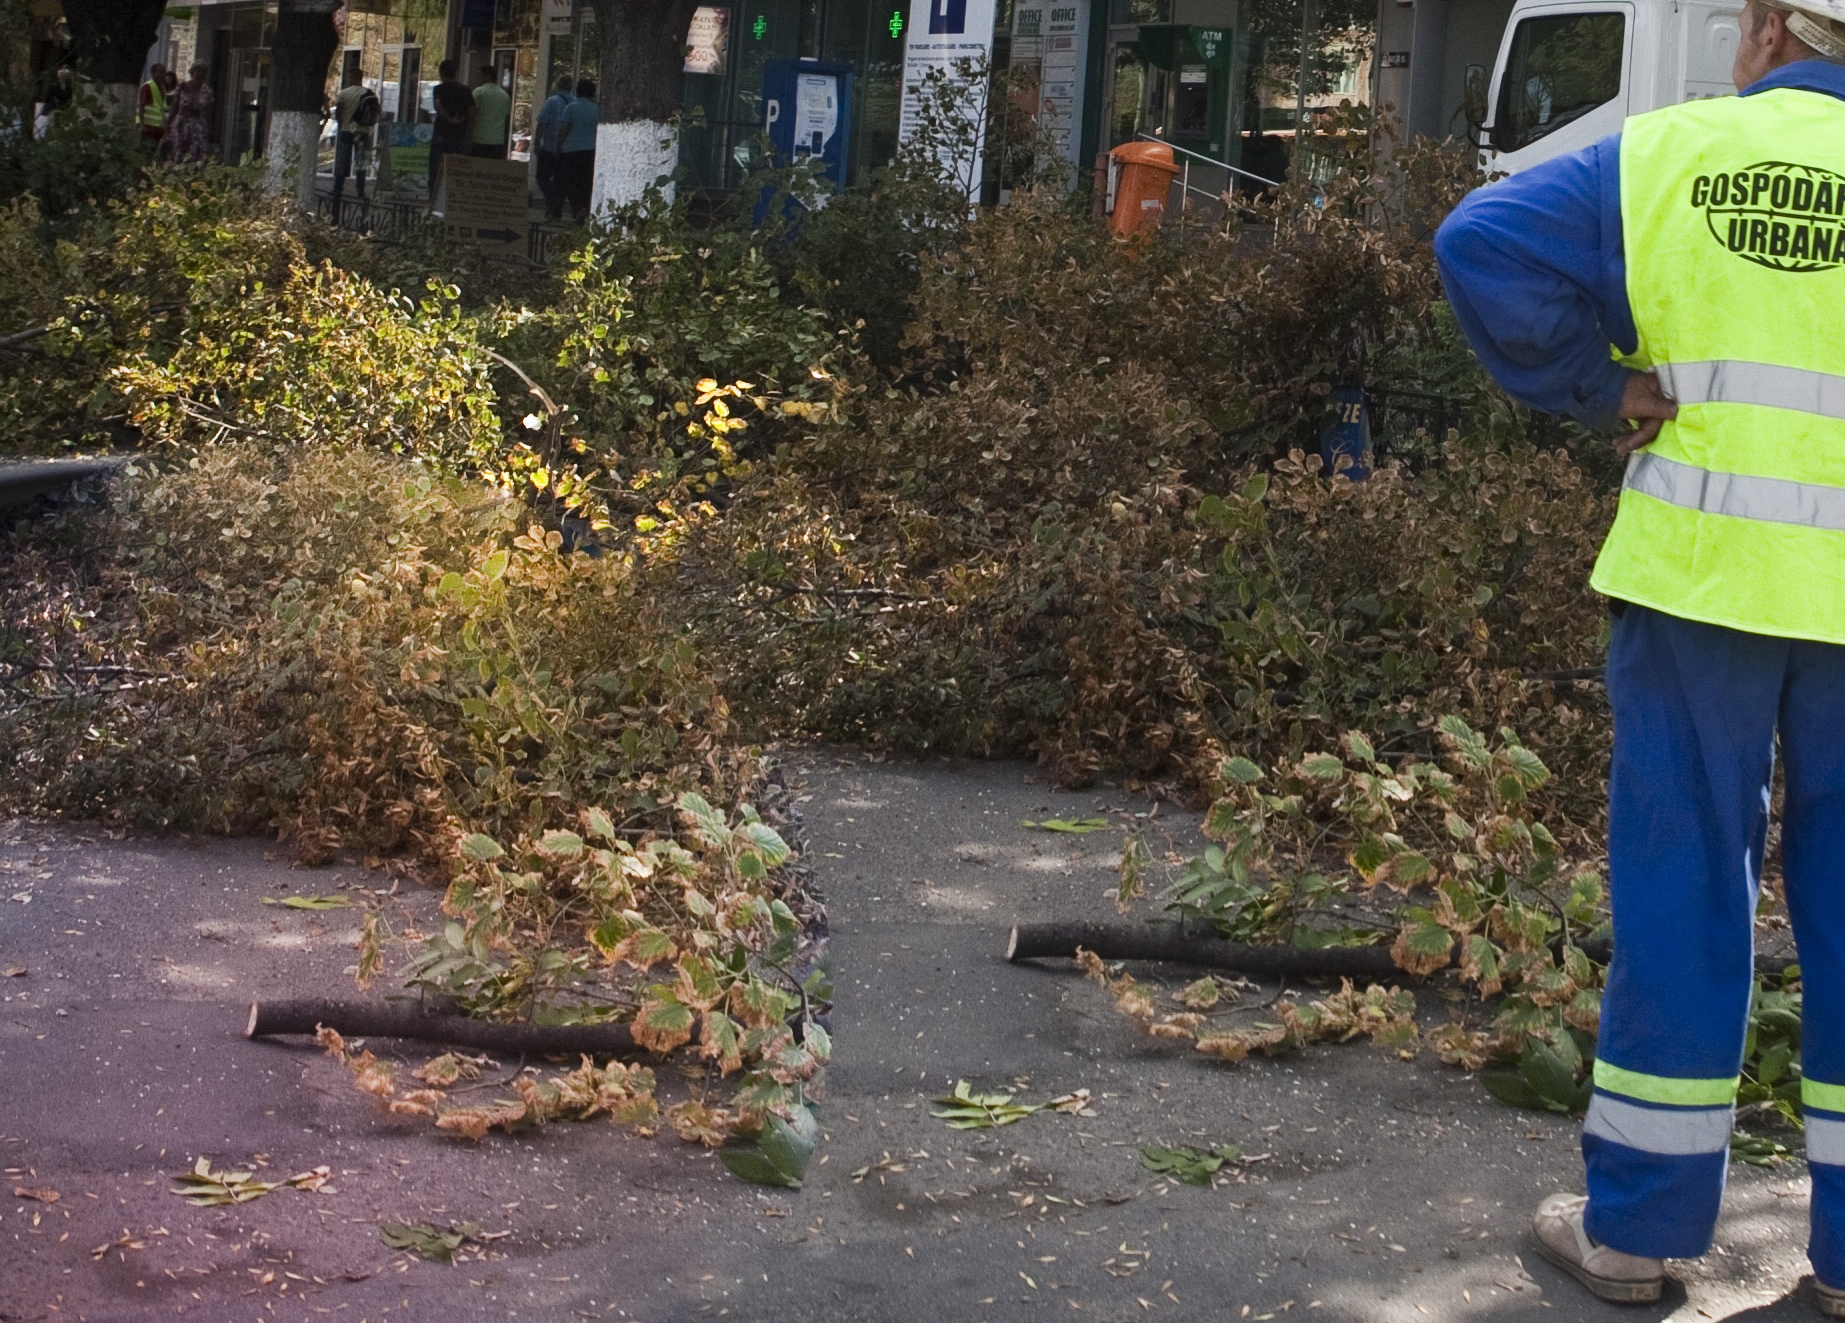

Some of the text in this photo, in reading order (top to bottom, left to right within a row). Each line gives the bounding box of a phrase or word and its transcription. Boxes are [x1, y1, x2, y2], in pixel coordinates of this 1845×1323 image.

[1019, 9, 1043, 22] OFFICE
[1051, 7, 1076, 22] OFFICE
[1201, 31, 1222, 41] ATM
[765, 99, 780, 133] P
